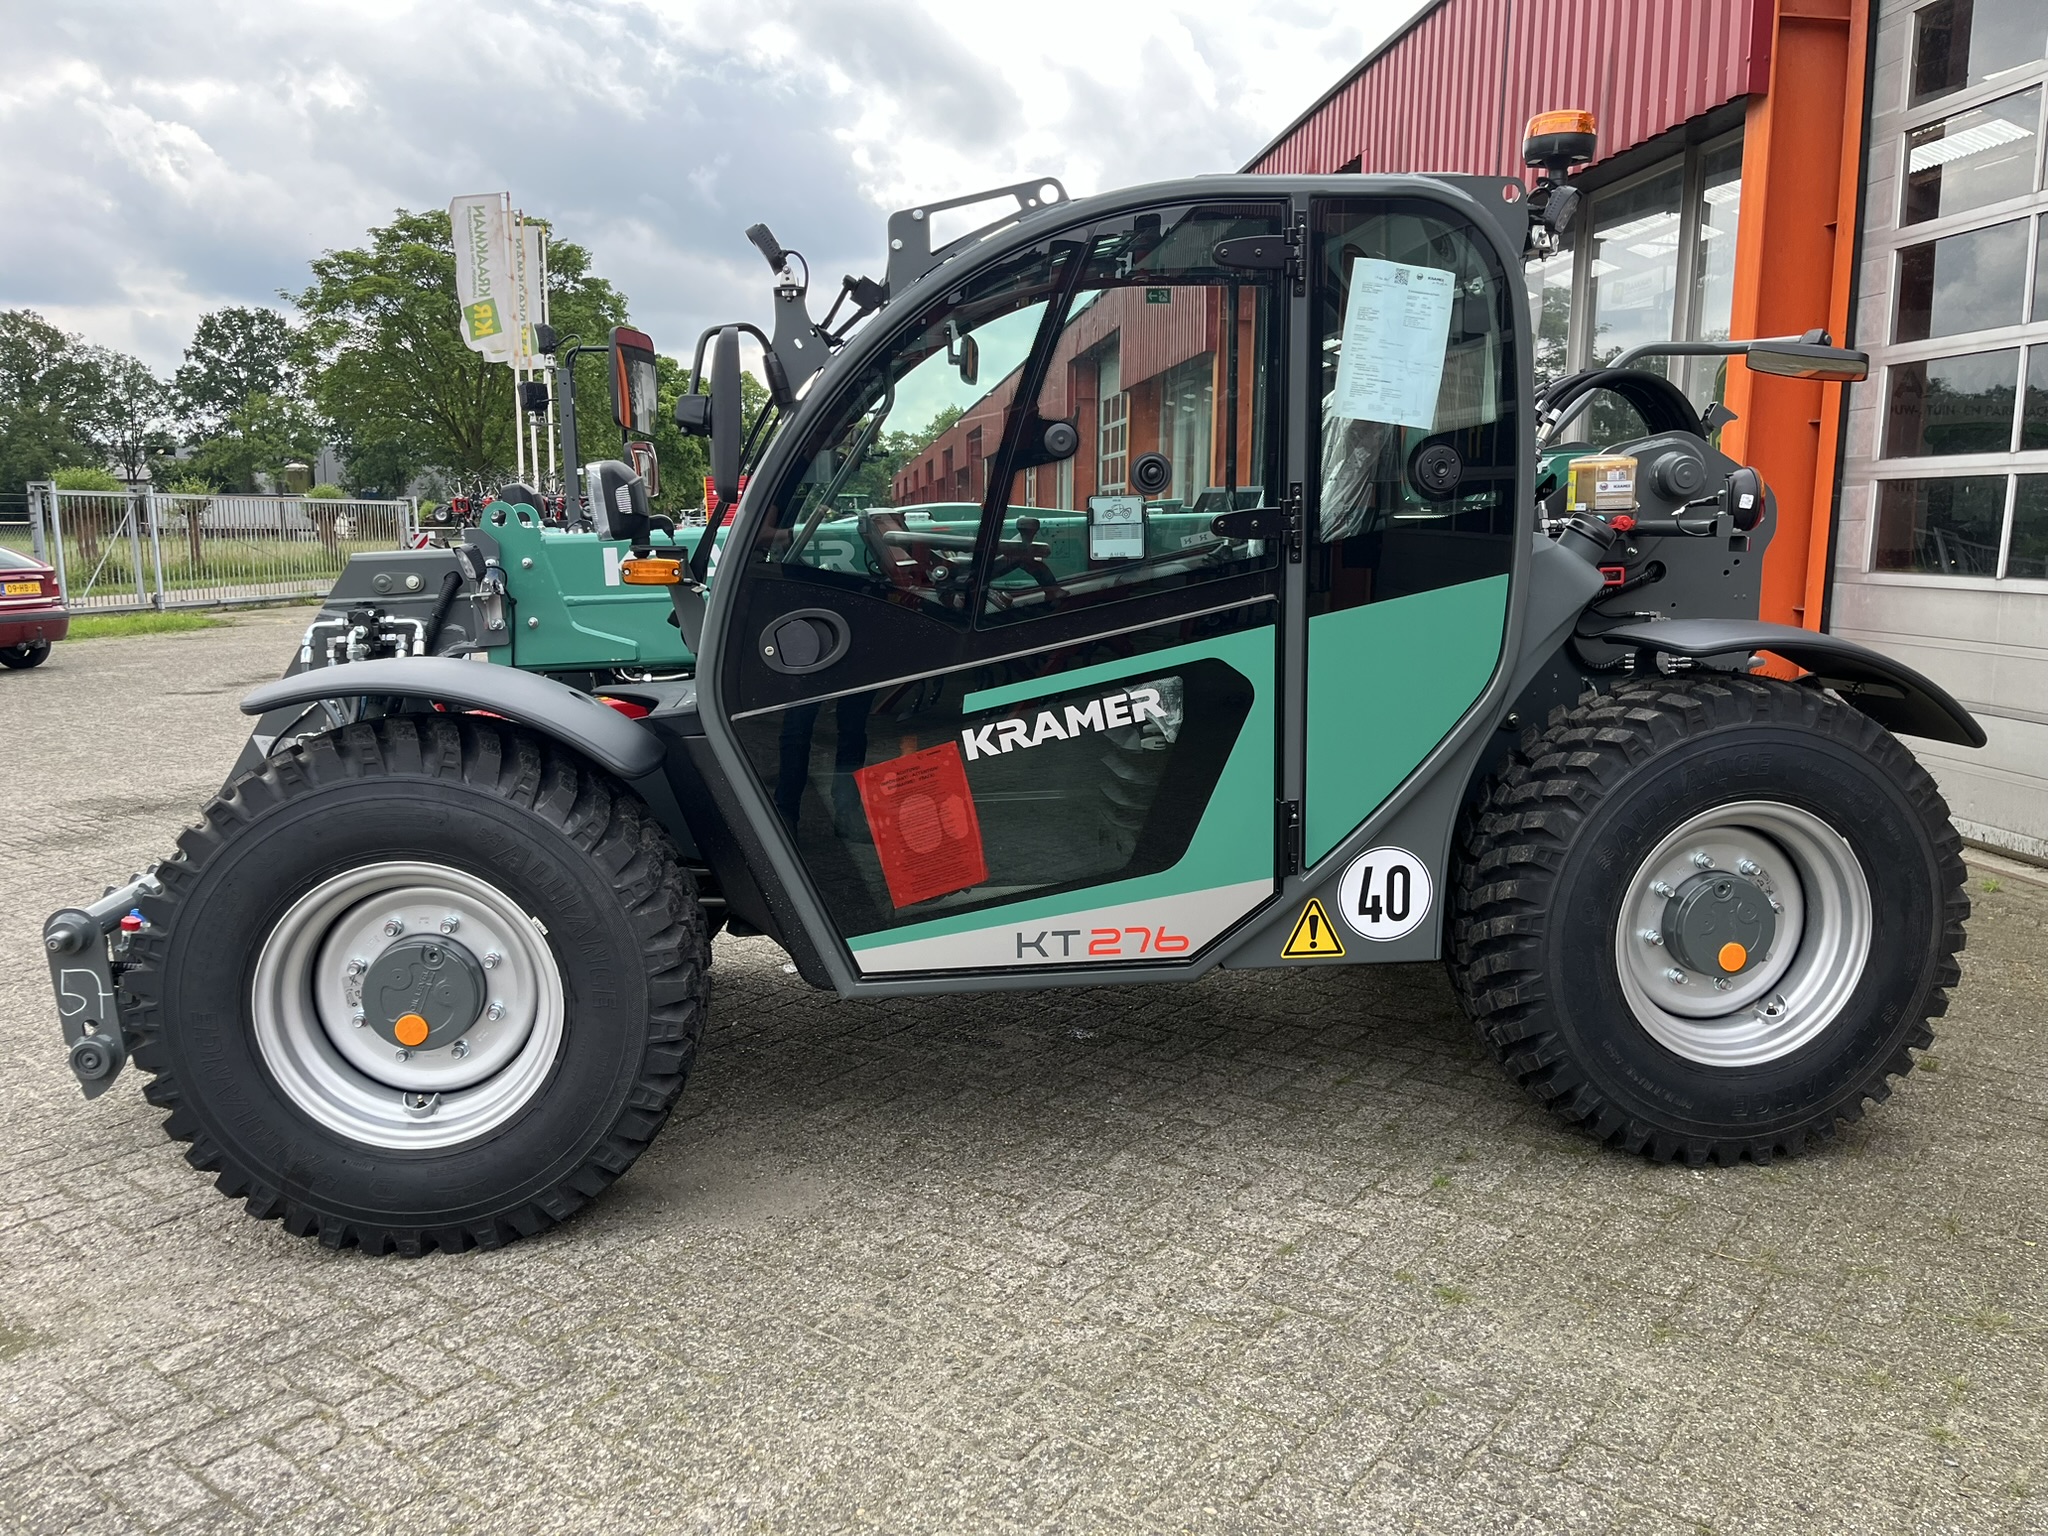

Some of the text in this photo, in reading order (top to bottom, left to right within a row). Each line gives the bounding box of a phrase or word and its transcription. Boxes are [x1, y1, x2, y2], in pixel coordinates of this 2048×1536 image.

[962, 689, 1168, 761] KRAMER
[1613, 752, 1773, 860] ALLIANCE
[489, 843, 618, 1010] ALLIANCE
[1358, 865, 1411, 923] 40
[1017, 926, 1190, 958] KT 276
[410, 970, 430, 1011] OIL LEVEL
[192, 1011, 326, 1170] ALLIANCE
